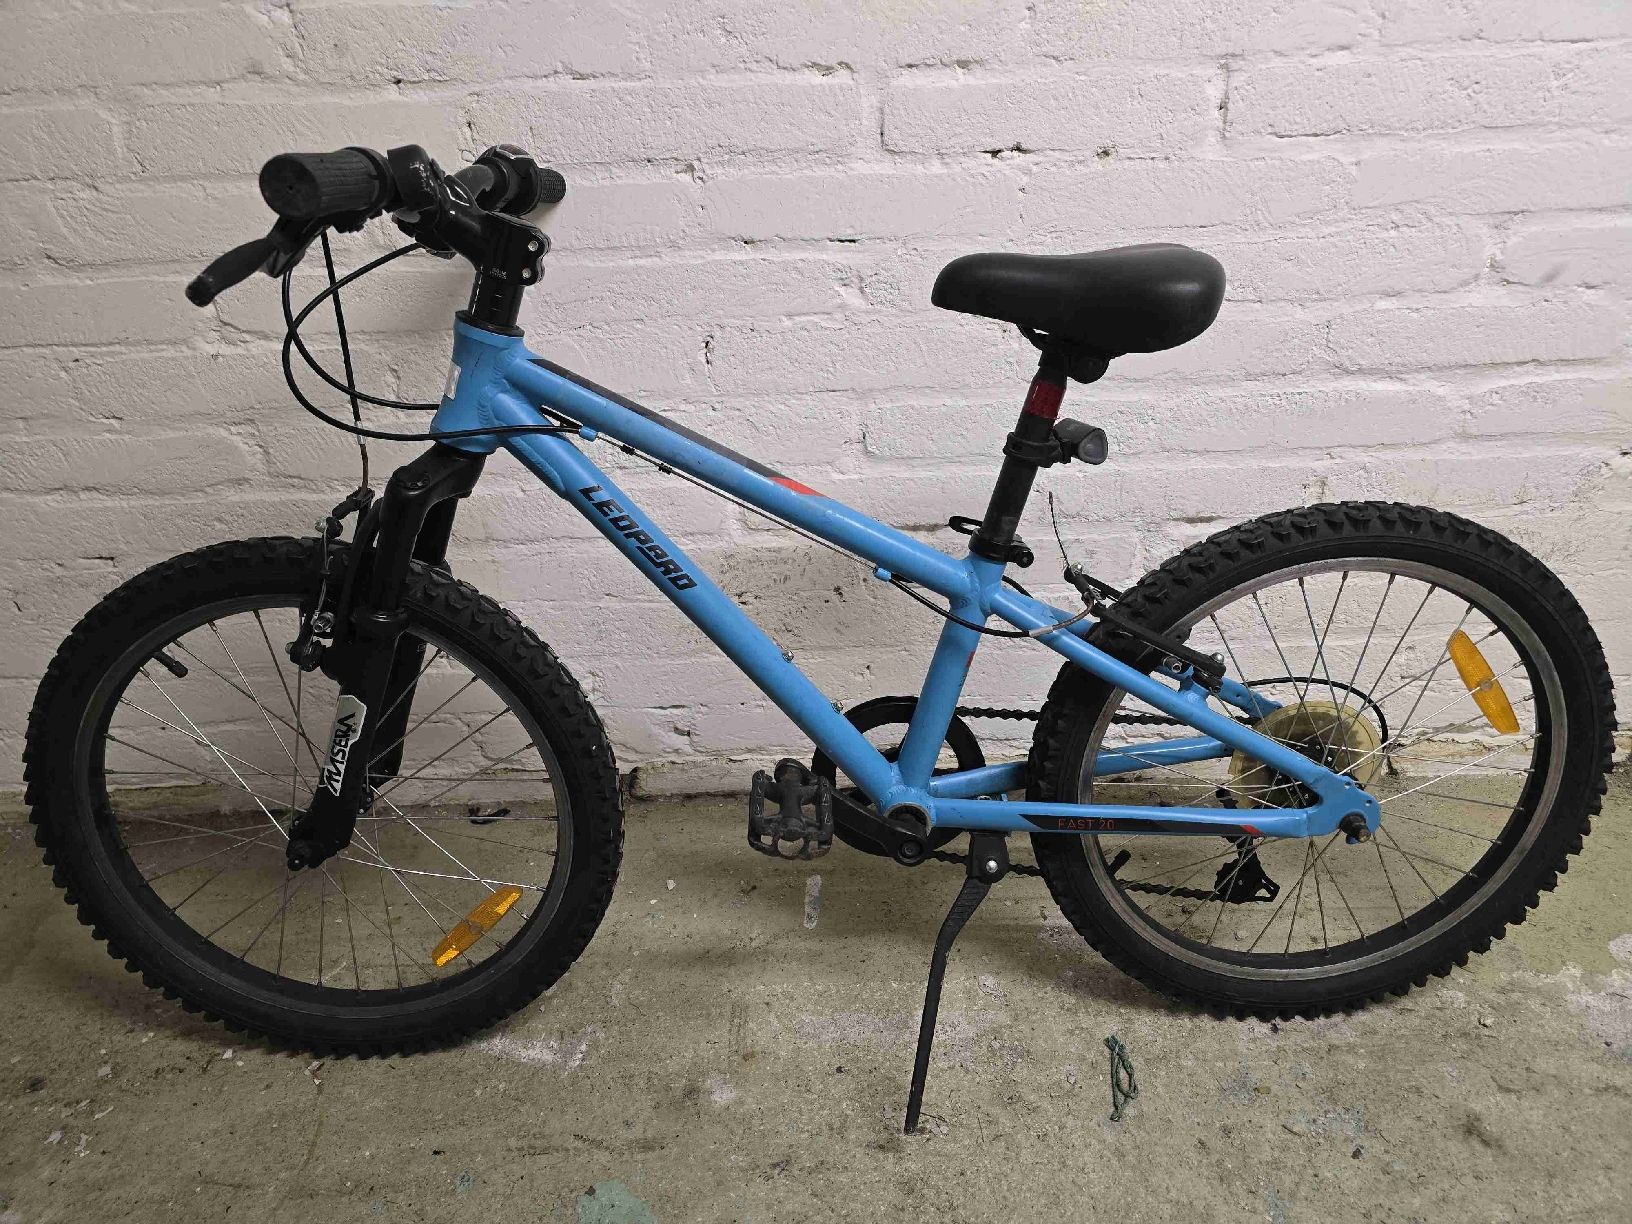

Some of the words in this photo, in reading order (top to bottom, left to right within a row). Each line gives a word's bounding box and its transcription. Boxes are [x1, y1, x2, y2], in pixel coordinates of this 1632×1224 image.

[578, 485, 698, 591] LEOPARD
[1058, 818, 1096, 831] FAST
[1099, 819, 1115, 831] 20
